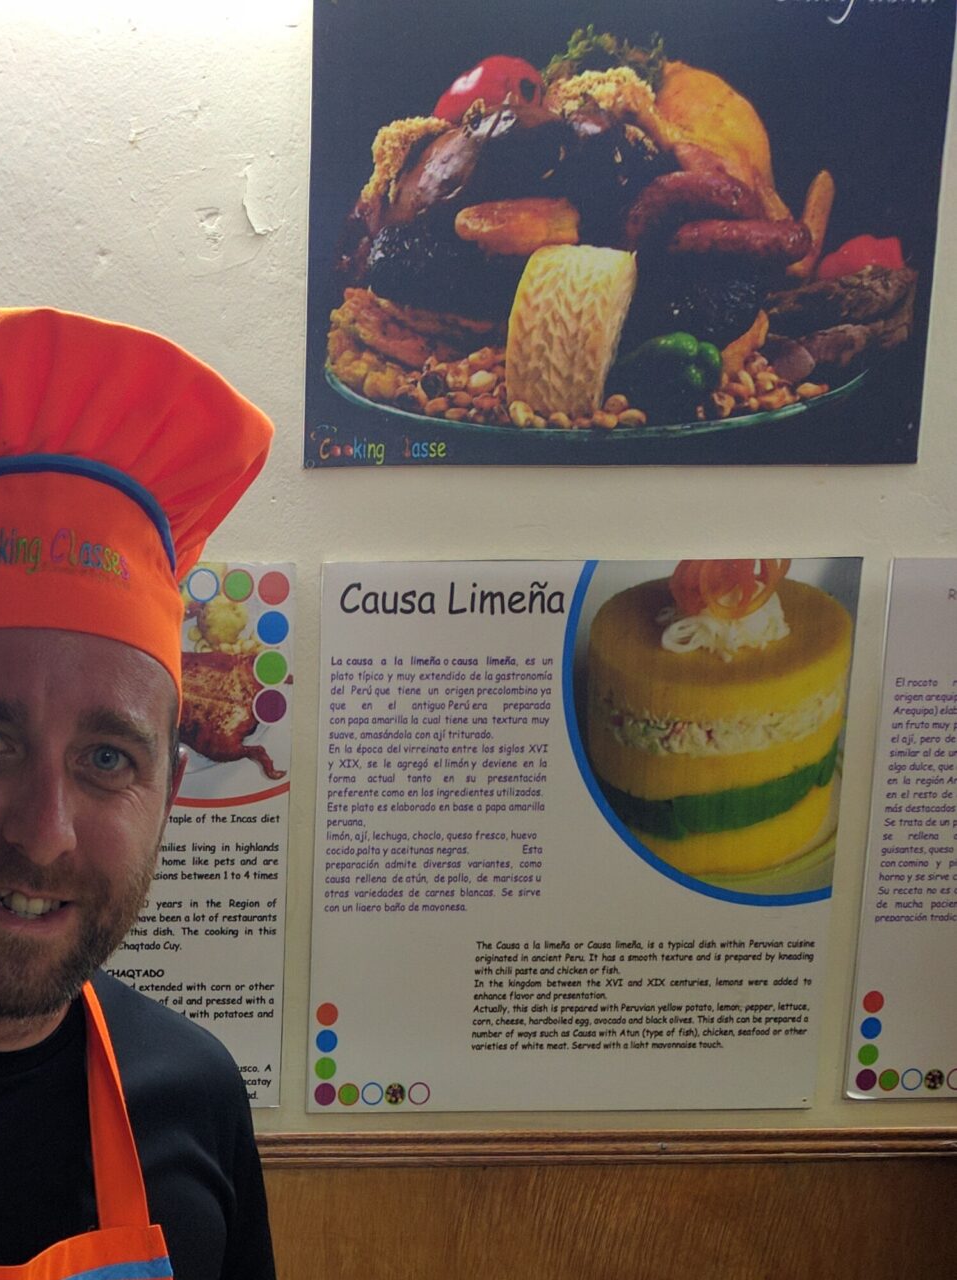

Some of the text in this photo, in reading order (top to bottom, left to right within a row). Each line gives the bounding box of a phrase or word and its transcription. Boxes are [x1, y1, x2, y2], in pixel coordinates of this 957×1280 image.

[50, 527, 131, 581] Classes
[339, 581, 568, 615] Causa Limeña
[328, 743, 340, 753] En
[386, 744, 401, 753] del
[403, 744, 449, 753] virreinato
[451, 744, 478, 753] entre
[481, 743, 495, 753] los
[498, 743, 525, 756] siglos
[528, 744, 548, 753] XVI
[888, 762, 907, 774] algo
[938, 764, 954, 774] que
[328, 773, 356, 783] forma
[367, 773, 395, 782] actual
[406, 774, 432, 782] tanto
[905, 803, 956, 813] destacados
[883, 818, 896, 826] Se
[898, 818, 923, 826] trata
[924, 817, 937, 826] de
[161, 856, 186, 865] home
[192, 856, 209, 865] like
[213, 857, 235, 867] pets
[239, 856, 257, 865] and
[384, 859, 417, 868] admite
[422, 859, 462, 868] diversas
[155, 901, 183, 910] years
[205, 898, 222, 907] the
[228, 898, 260, 910] Region
[266, 898, 277, 907] of
[474, 966, 493, 974] with
[494, 966, 512, 975] chili
[514, 967, 538, 977] paste
[539, 966, 555, 974] and
[556, 966, 588, 974] chicken
[138, 982, 183, 992] extended
[185, 982, 206, 991] with
[248, 982, 275, 990] other
